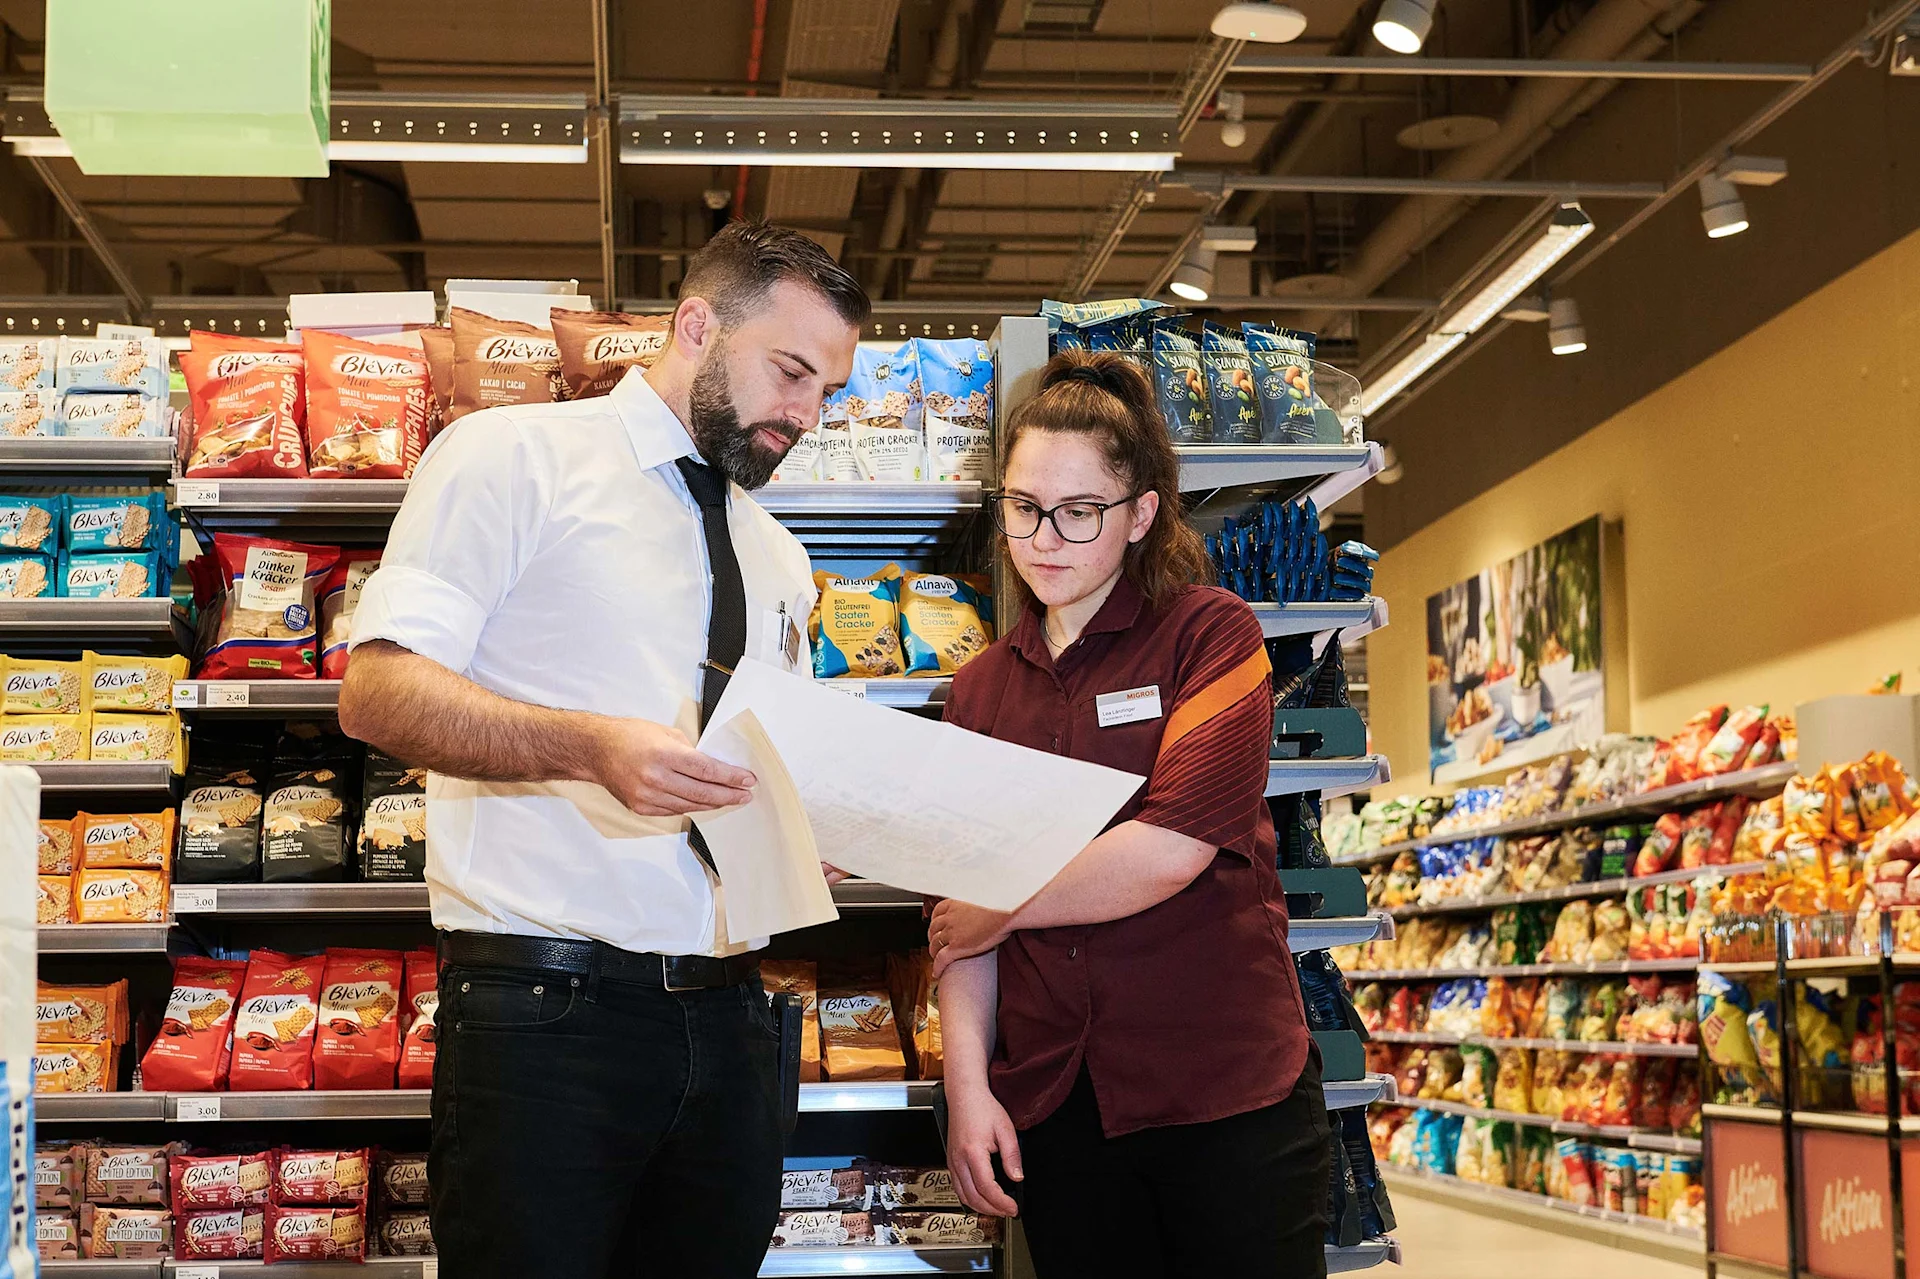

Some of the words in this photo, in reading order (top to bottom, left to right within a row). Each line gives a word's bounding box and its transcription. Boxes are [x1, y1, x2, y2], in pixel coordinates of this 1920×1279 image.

[486, 361, 518, 375] Mini
[877, 365, 890, 379] YOU
[479, 378, 500, 388] KAKAO
[506, 379, 526, 390] CACAO
[593, 380, 614, 391] KAKAO
[337, 387, 360, 399] TOMATE
[366, 392, 401, 403] POMODORO
[273, 373, 302, 469] CRUNCHIES
[197, 491, 217, 500] 2.80
[257, 560, 295, 575] Dinkel
[250, 569, 299, 585] Kräcker
[259, 582, 287, 593] Sesam
[915, 580, 954, 590] Alnavit
[834, 603, 871, 611] GLUTENFREI
[834, 611, 870, 620] Saaten
[919, 611, 953, 619] Saaten
[835, 619, 875, 629] Cracker
[921, 618, 960, 626] Cracker
[226, 693, 246, 702] 2.40
[1126, 689, 1155, 700] MIGROS
[194, 898, 214, 907] 3.00
[198, 1107, 217, 1116] 3.00
[99, 1167, 124, 1179] LIMITED
[126, 1166, 152, 1178] EDITION
[391, 1165, 427, 1182] BléVi
[1725, 1160, 1779, 1227] Aktion
[1819, 1175, 1884, 1245] Aktion
[39, 1228, 65, 1239] EDITION
[107, 1229, 130, 1240] LIMITED
[134, 1228, 161, 1240] EDITION
